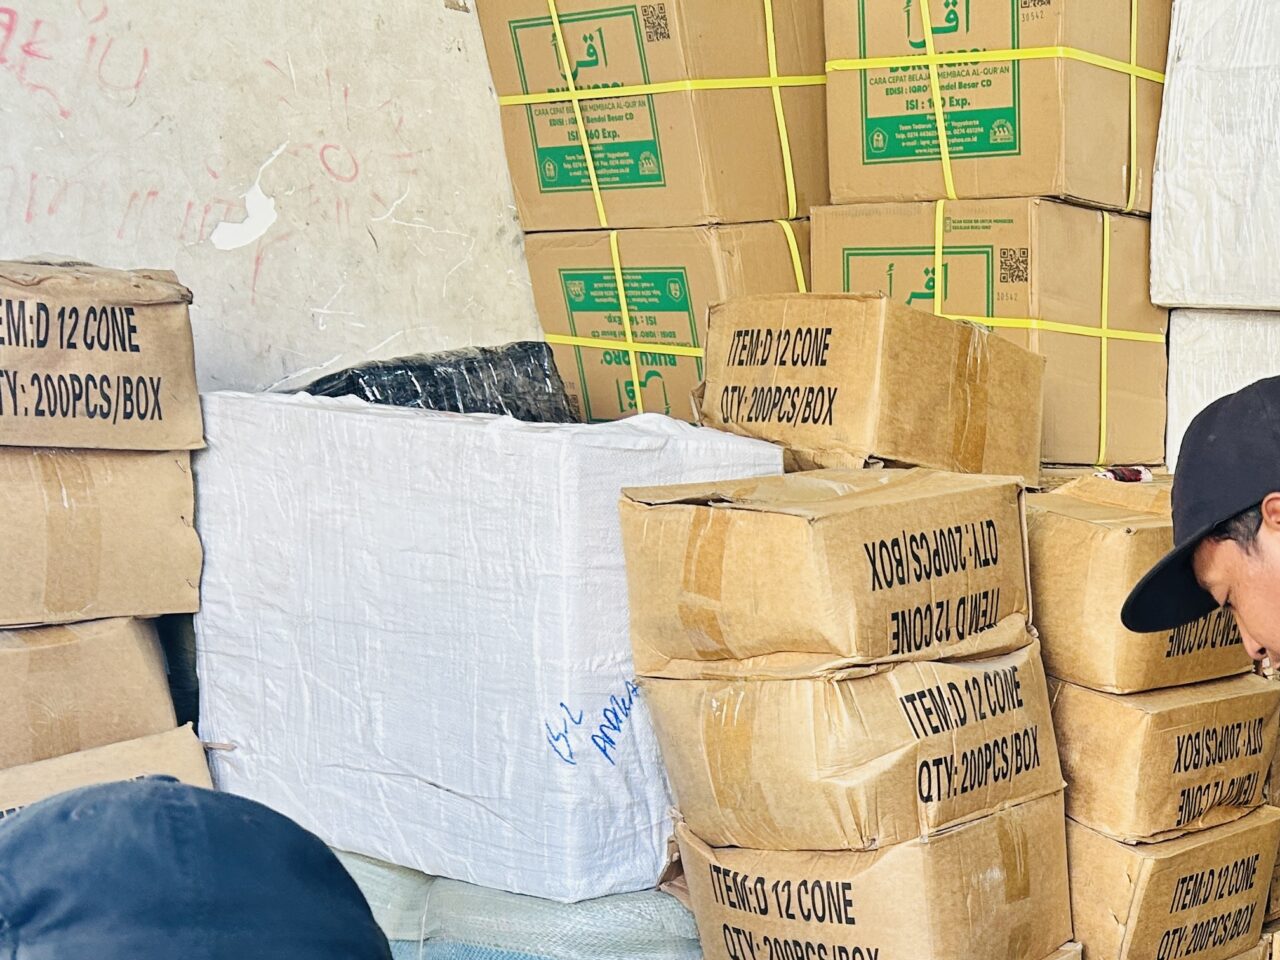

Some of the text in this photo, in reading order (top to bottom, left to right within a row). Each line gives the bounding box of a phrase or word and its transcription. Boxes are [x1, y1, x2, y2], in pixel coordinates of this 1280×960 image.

[870, 77, 887, 86] CARA
[888, 76, 906, 84] CEPAT
[908, 73, 932, 82] BELAJA
[886, 87, 903, 96] EDISI
[958, 80, 979, 89] Besar
[981, 79, 992, 87] CD
[906, 100, 918, 111] ISI
[928, 97, 946, 108] 10
[949, 96, 971, 110] Exp.
[58, 306, 79, 349] 12
[83, 306, 140, 352] CONE
[727, 327, 832, 367] ITEM:D 12 CONE
[31, 372, 162, 425] 200PCS/BOX
[720, 386, 838, 428] QTY: 200PCS/BOX
[864, 519, 998, 591] QTY: 200PCS/BOX
[891, 588, 1000, 655] ITEM:D 12 CONE
[900, 665, 1023, 739] ITEM:D 12 CONE
[918, 725, 1040, 804] QTY: 200PCS/BOX
[709, 863, 856, 925] ITEM:D 12 CONE
[1170, 853, 1260, 914] ITEM:D 12 CONE
[1185, 902, 1257, 957] 200PCS/BOX
